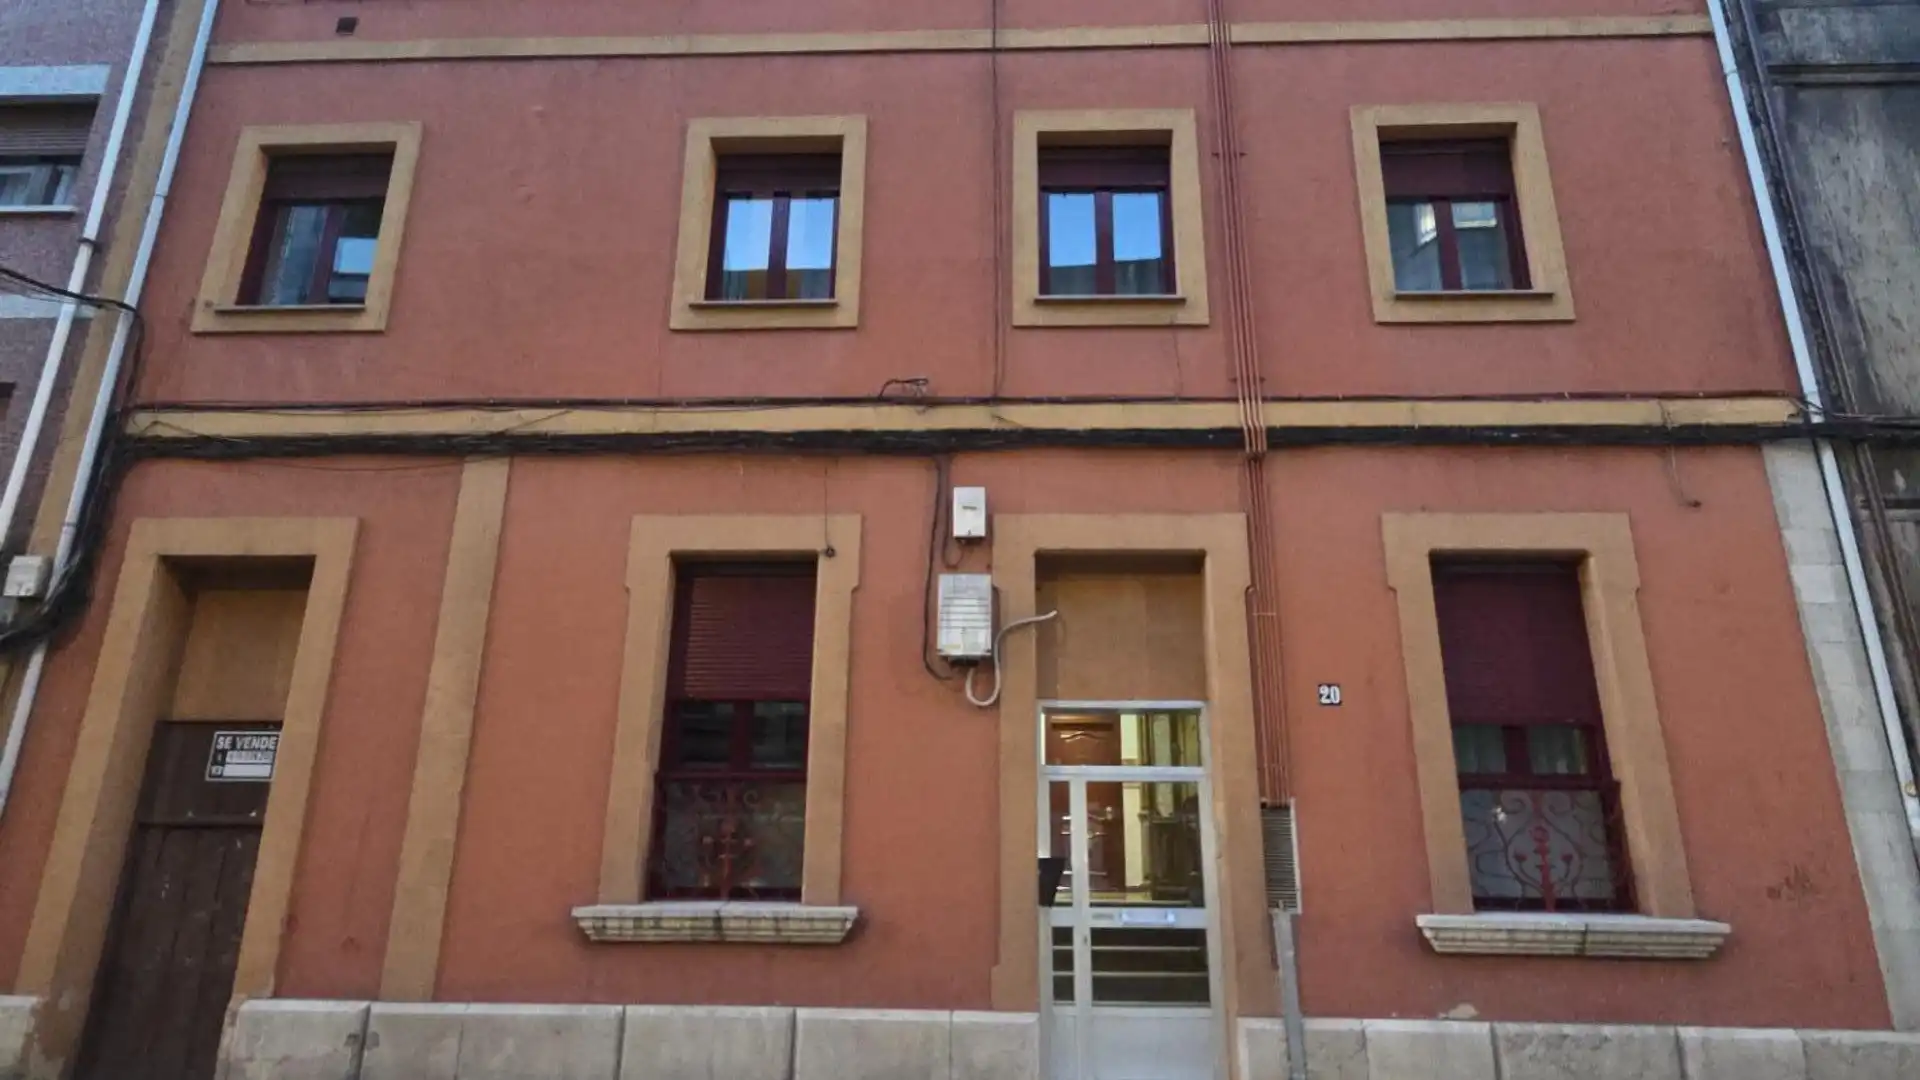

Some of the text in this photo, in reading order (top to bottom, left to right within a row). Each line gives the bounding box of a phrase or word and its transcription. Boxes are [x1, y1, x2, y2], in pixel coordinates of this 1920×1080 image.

[1319, 684, 1340, 704] 20
[215, 735, 277, 750] SE VENDE
